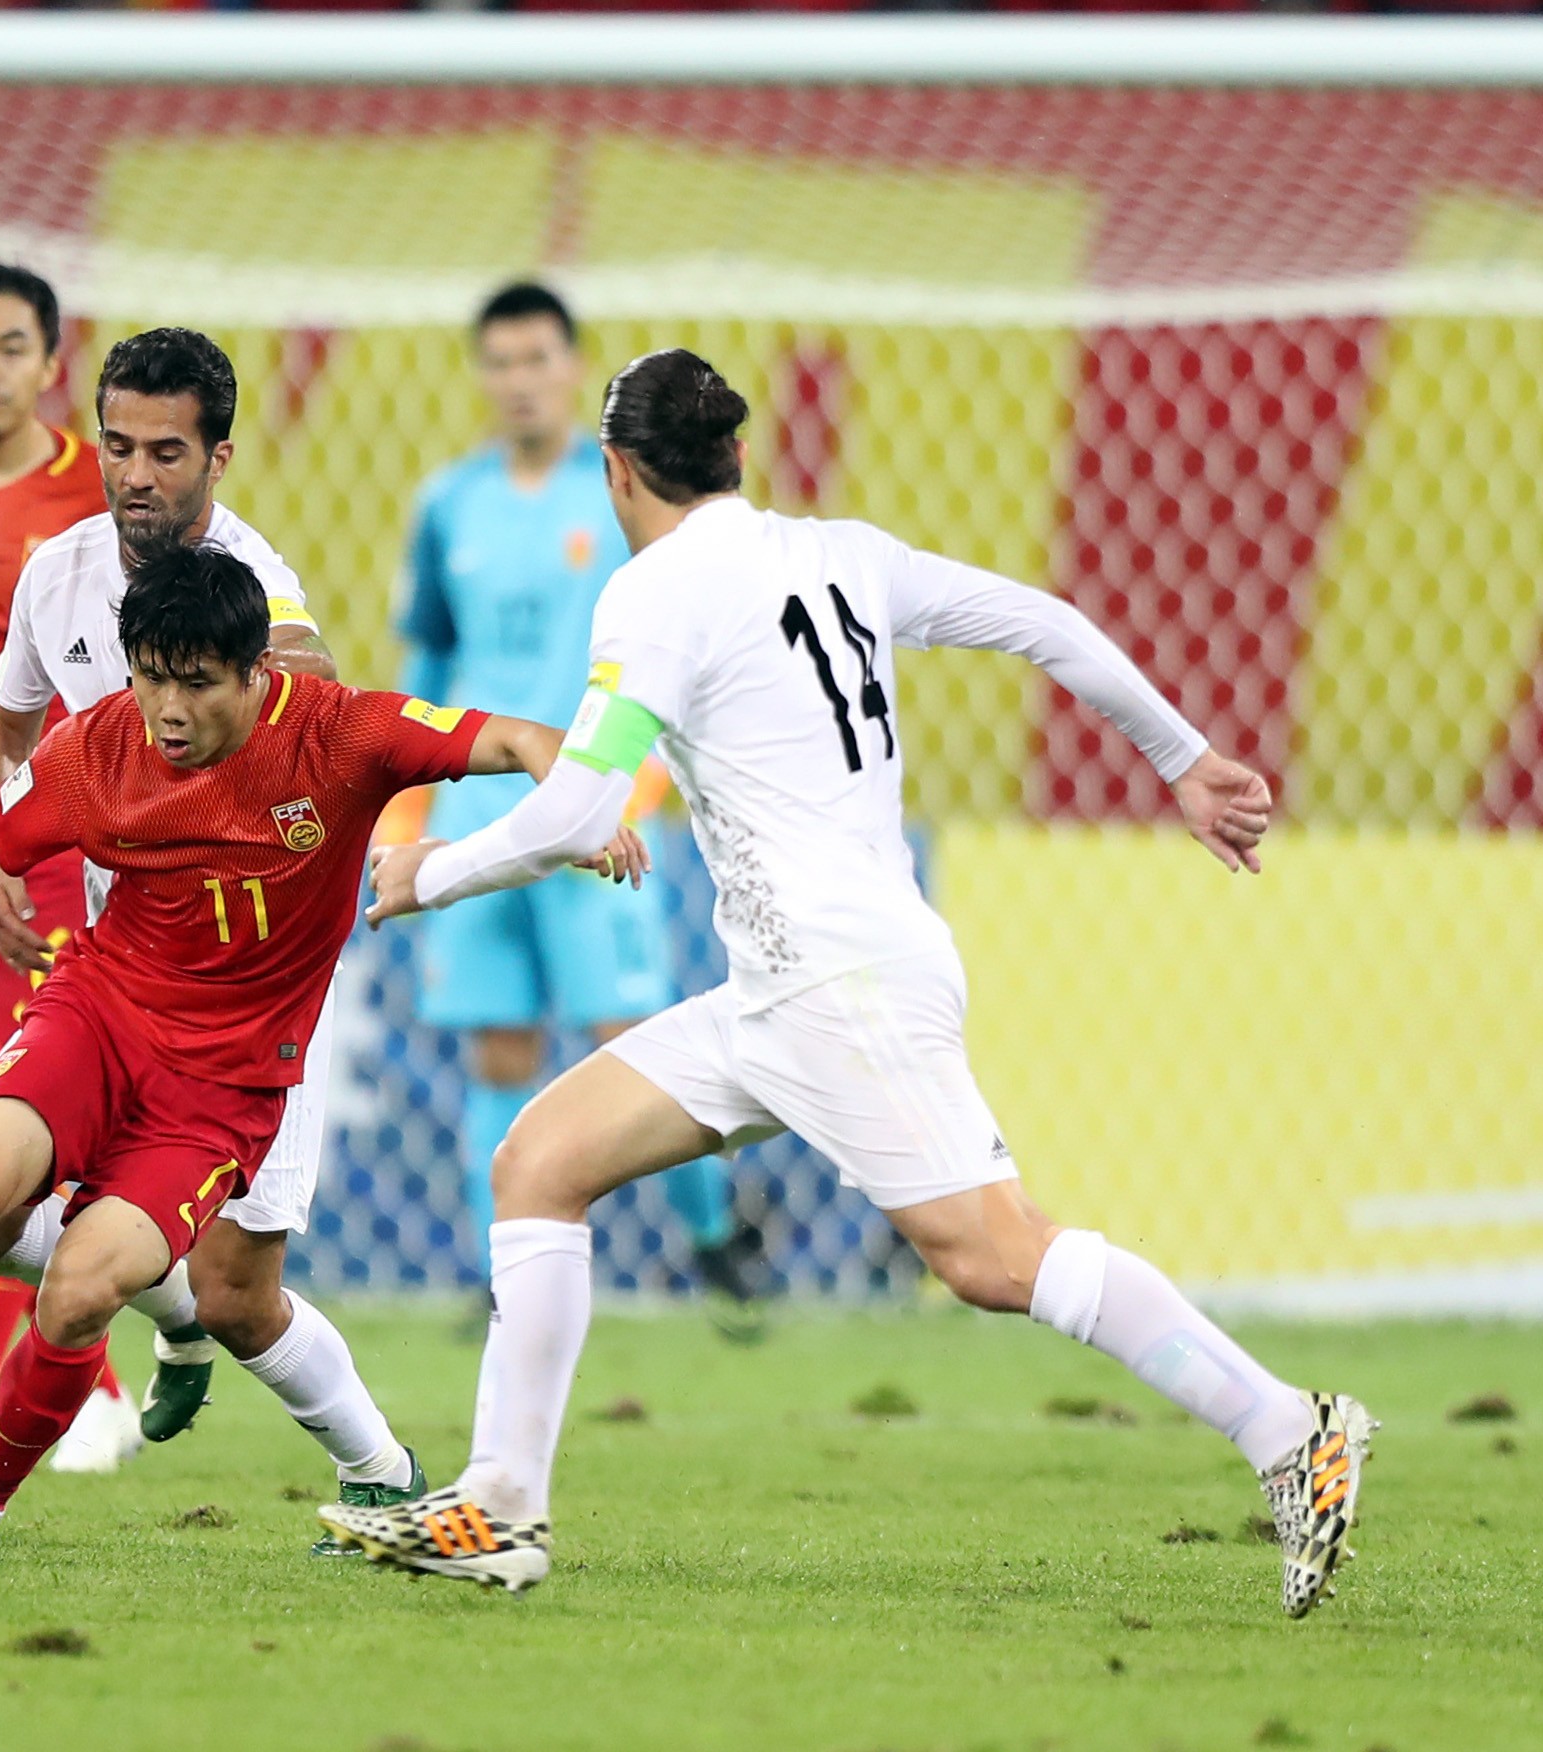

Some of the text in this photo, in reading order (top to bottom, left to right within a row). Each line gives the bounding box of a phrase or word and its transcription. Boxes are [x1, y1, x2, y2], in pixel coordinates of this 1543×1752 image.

[63, 653, 92, 664] adidas
[779, 582, 895, 774] 14
[421, 705, 435, 721] FIF
[275, 801, 311, 820] CFA
[203, 877, 269, 944] 11
